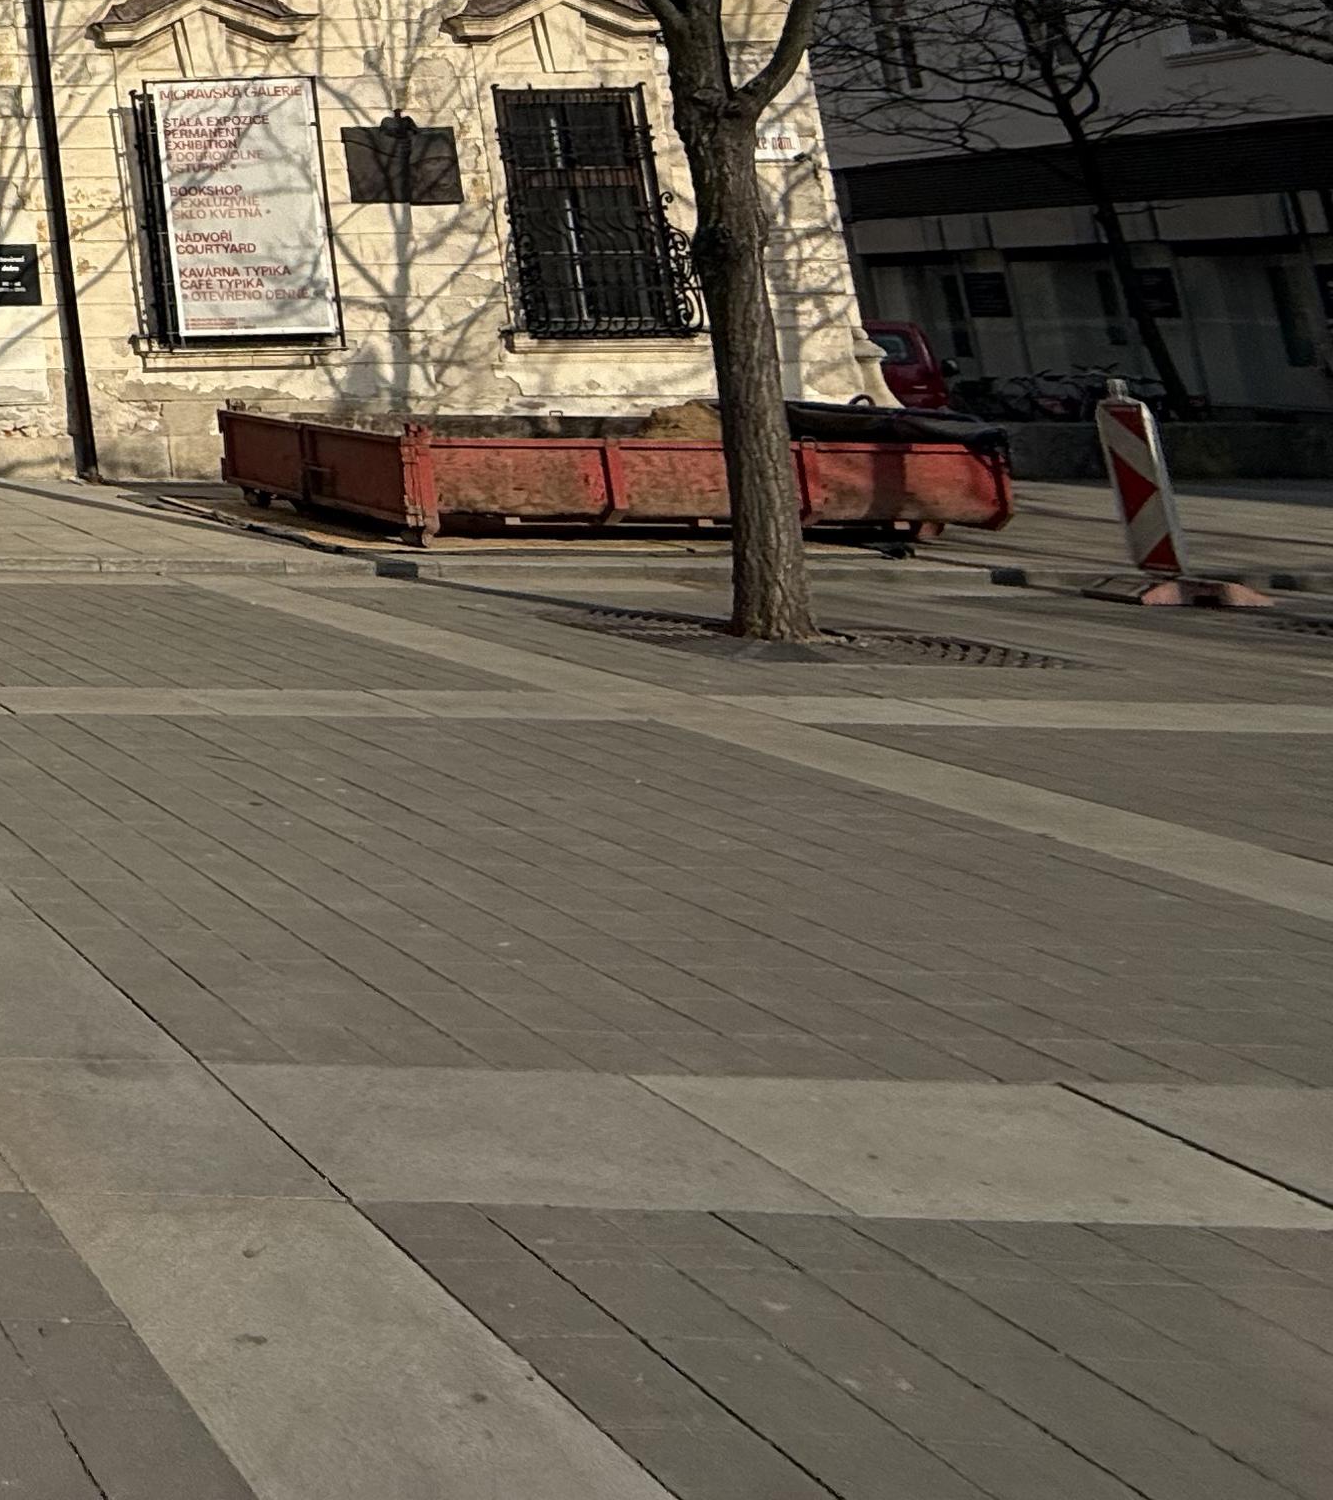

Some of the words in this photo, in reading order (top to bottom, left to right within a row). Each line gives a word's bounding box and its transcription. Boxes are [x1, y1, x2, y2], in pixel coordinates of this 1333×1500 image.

[244, 85, 302, 97] GALERIE
[206, 115, 270, 127] EXPOZICE
[164, 128, 242, 139] PERMANENT
[165, 139, 238, 150] EXHIBITION
[170, 184, 243, 197] BOOKSHOP
[172, 209, 206, 220] SKLO
[175, 230, 232, 242] NÁDVOŘÍ
[176, 243, 256, 254] COURTYARD
[179, 265, 241, 278] KAVÁRNA
[244, 266, 291, 277] TYPIKA
[217, 278, 265, 289] TYPIKA
